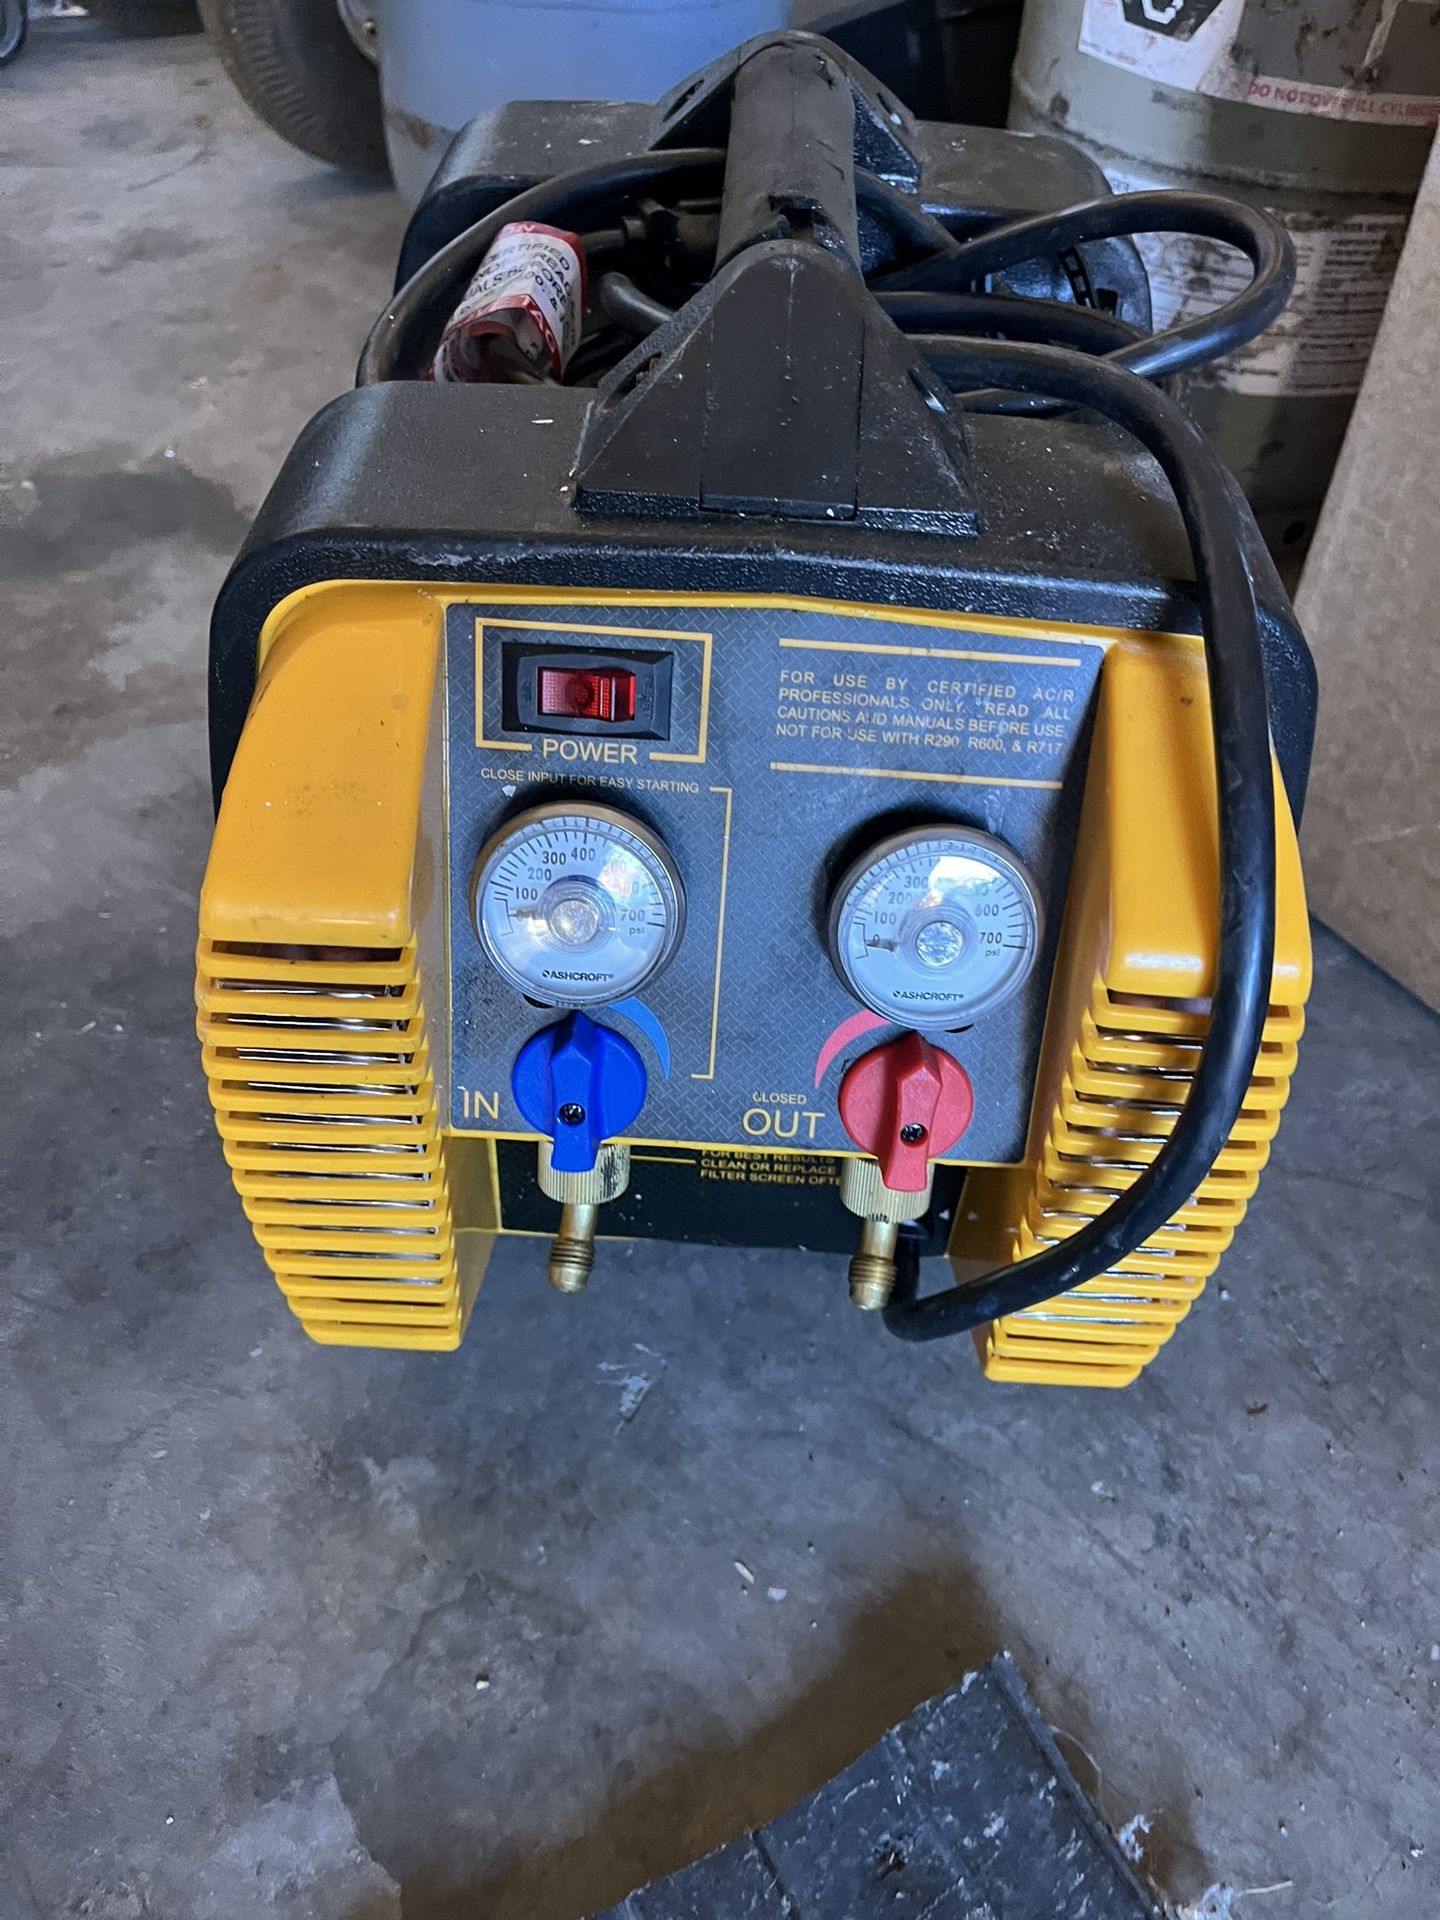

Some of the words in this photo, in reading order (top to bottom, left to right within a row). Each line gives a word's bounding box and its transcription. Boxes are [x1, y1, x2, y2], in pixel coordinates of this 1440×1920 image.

[780, 670, 815, 685] FOR
[833, 674, 868, 688] USE
[886, 677, 908, 691] BY
[927, 680, 1016, 699] CERTIFIED
[1033, 687, 1074, 703] AC/R
[779, 688, 910, 709] PROFESSIONALS
[984, 702, 1029, 717] READ
[1043, 706, 1071, 721] ALL
[777, 706, 851, 723] CAUTIONS
[856, 711, 887, 726] AND
[892, 714, 964, 731] MANUALS
[968, 719, 1030, 736] BEFORE
[1033, 724, 1065, 738] USE
[776, 723, 807, 738] NOT
[811, 726, 842, 740] FOR
[848, 729, 877, 742] USE
[882, 731, 919, 746] WITH
[1012, 740, 1022, 752] &
[543, 739, 638, 764] POWER
[481, 767, 524, 781] CLOSE
[528, 771, 567, 785] INPUT
[570, 774, 596, 786] FOR
[599, 775, 634, 789] EASY
[637, 778, 699, 793] STARTING
[542, 852, 566, 865] 300
[571, 847, 595, 861] 400
[528, 867, 552, 881] 200
[904, 876, 928, 889] 300
[516, 887, 538, 901] 100
[888, 892, 912, 905] 200
[621, 909, 645, 921] 700
[975, 903, 999, 917] 600
[874, 912, 896, 925] 100
[629, 926, 645, 936] psi
[980, 932, 1002, 944] 700
[985, 949, 1000, 959] psi
[464, 1090, 498, 1120] IN
[752, 1091, 807, 1105] CLOSED
[743, 1108, 825, 1139] OUT
[701, 1159, 746, 1170] CLEAN
[749, 1162, 770, 1171] OR
[773, 1163, 835, 1175] REPLACE
[700, 1169, 745, 1180] FILTER
[749, 1172, 804, 1185] SCREEN
